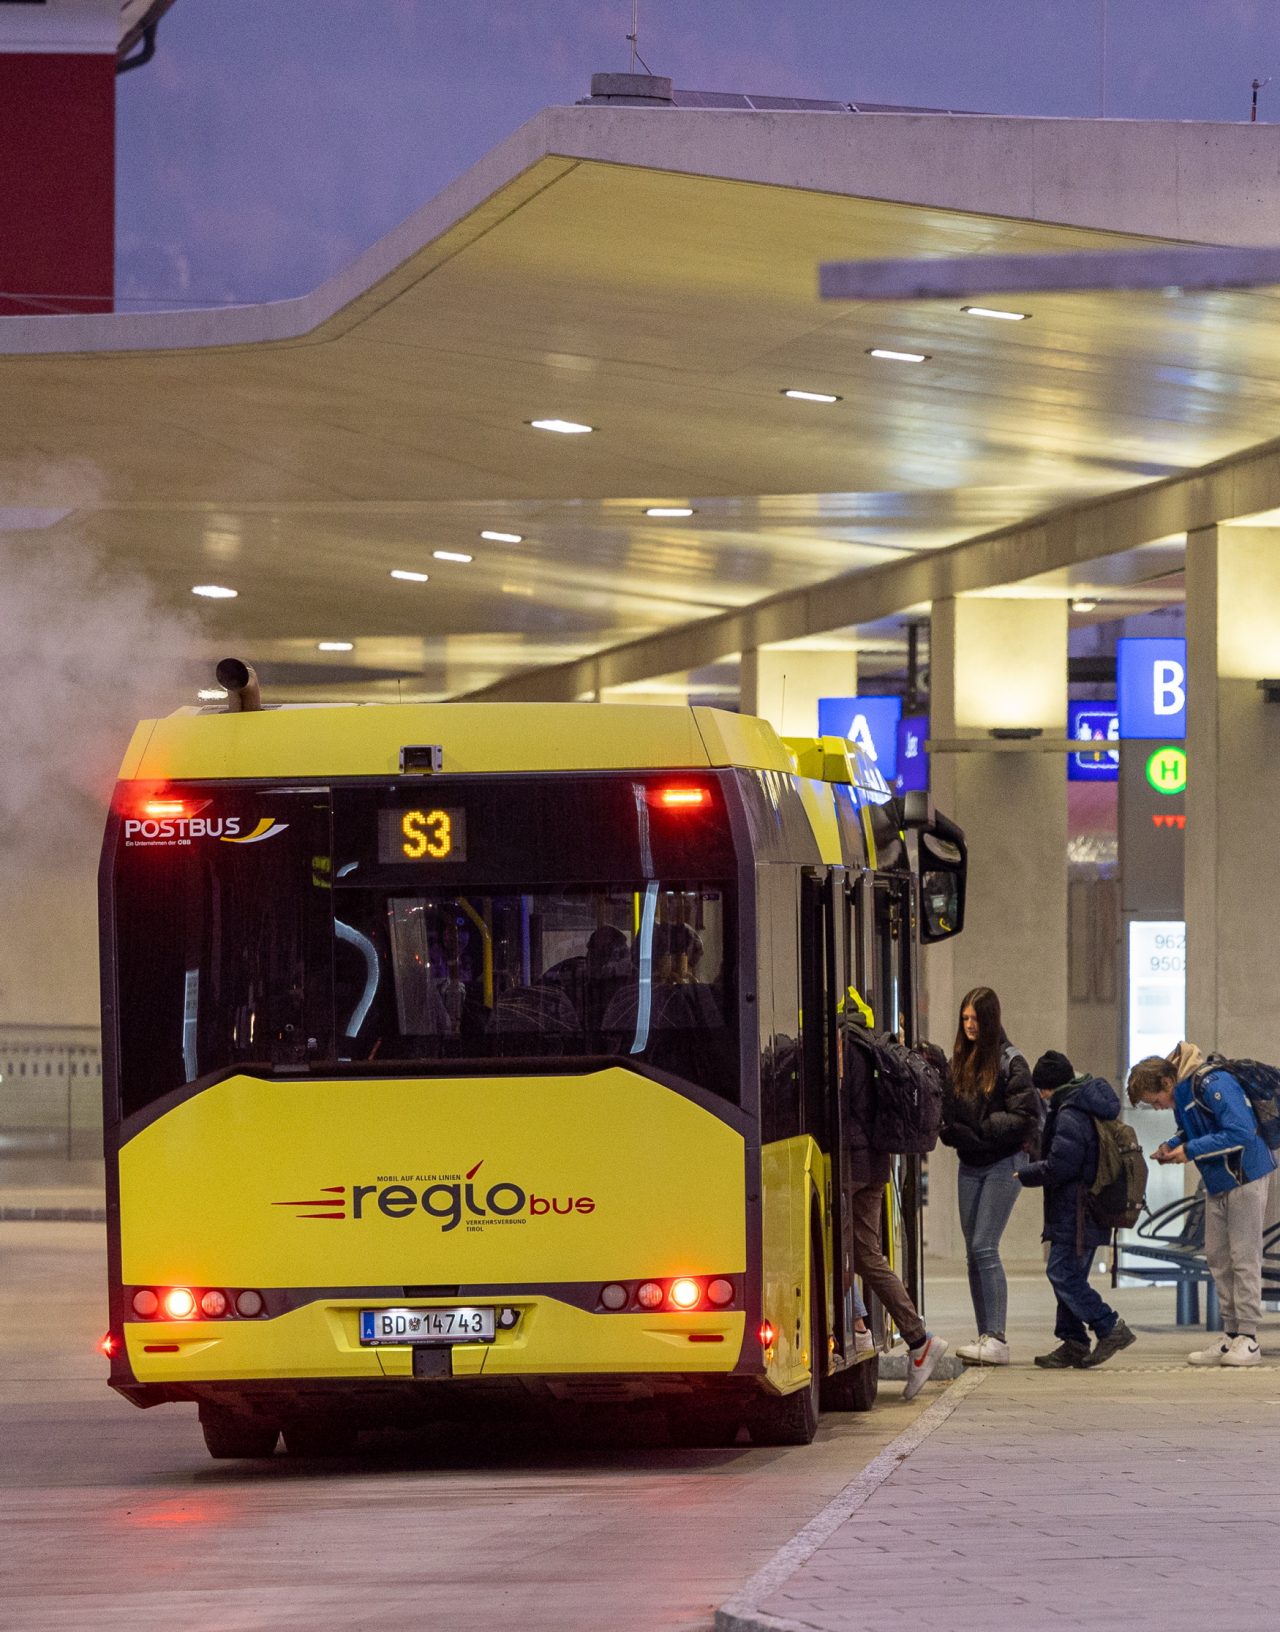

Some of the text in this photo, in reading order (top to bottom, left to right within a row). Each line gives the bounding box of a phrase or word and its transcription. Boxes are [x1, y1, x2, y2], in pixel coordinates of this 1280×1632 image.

[1153, 660, 1185, 715] B
[847, 714, 878, 761] A
[1161, 760, 1179, 780] H
[125, 817, 240, 839] POSTBUS
[402, 811, 452, 858] S3
[465, 1218, 527, 1226] VERKEHRSVERBUND
[382, 1313, 483, 1335] BD 14743
